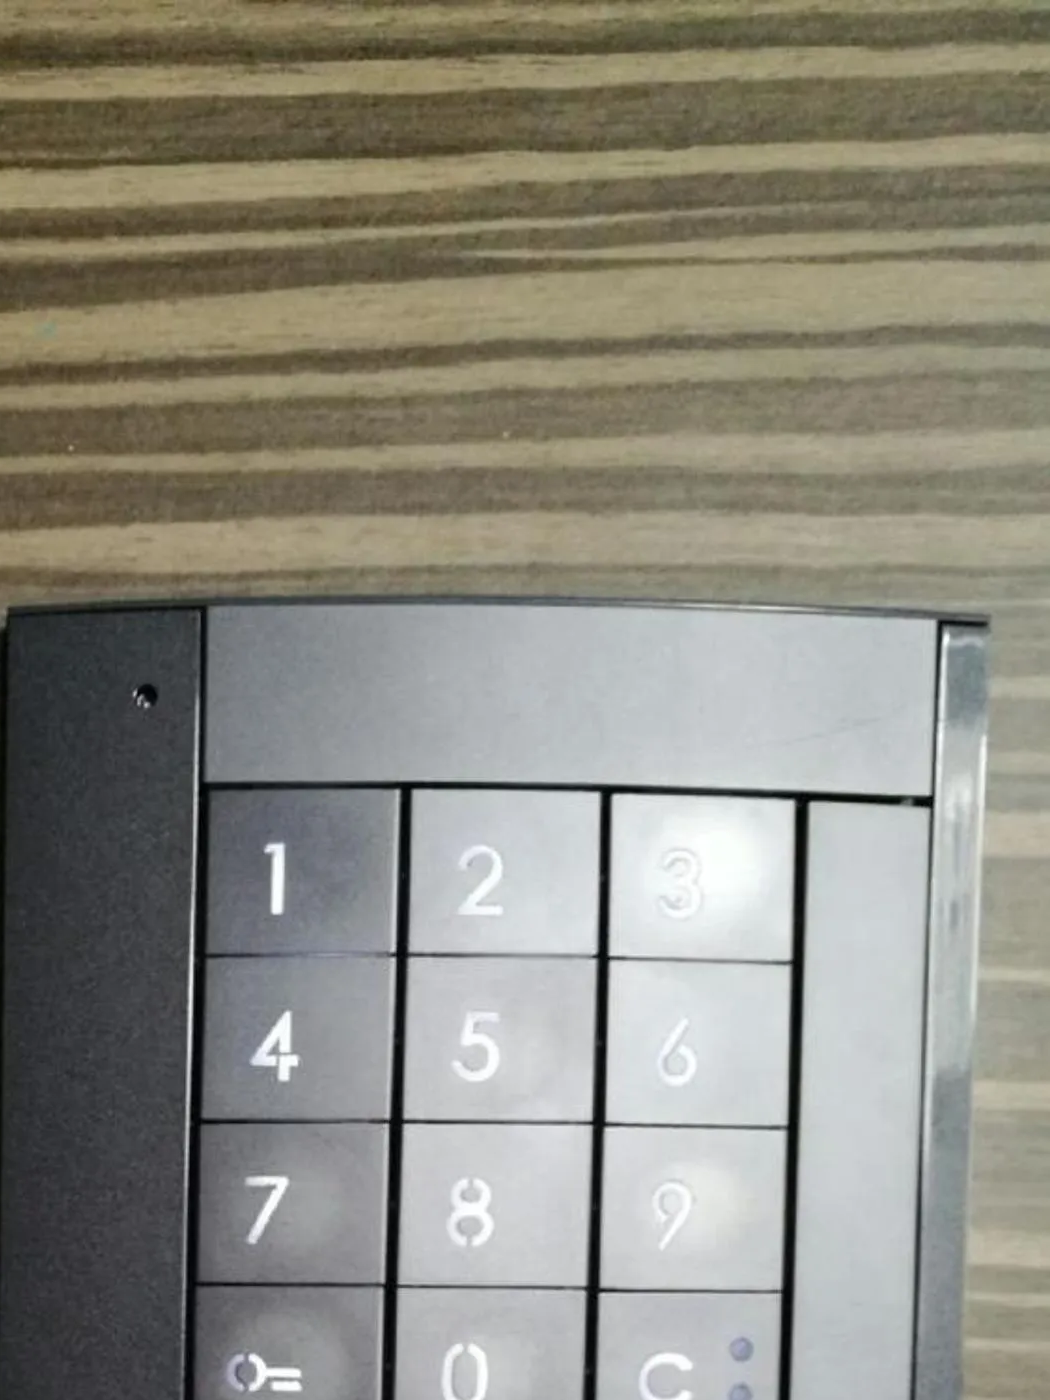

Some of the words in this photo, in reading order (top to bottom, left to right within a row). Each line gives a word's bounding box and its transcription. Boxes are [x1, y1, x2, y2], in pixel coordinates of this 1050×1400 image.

[264, 843, 286, 915] 1
[457, 845, 504, 916] 2
[658, 848, 703, 919] 3
[250, 1011, 301, 1082] 4
[452, 1012, 501, 1082] 5
[657, 1018, 698, 1087] 6
[245, 1176, 290, 1245] 7
[446, 1178, 495, 1247] 8
[652, 1180, 694, 1250] 9
